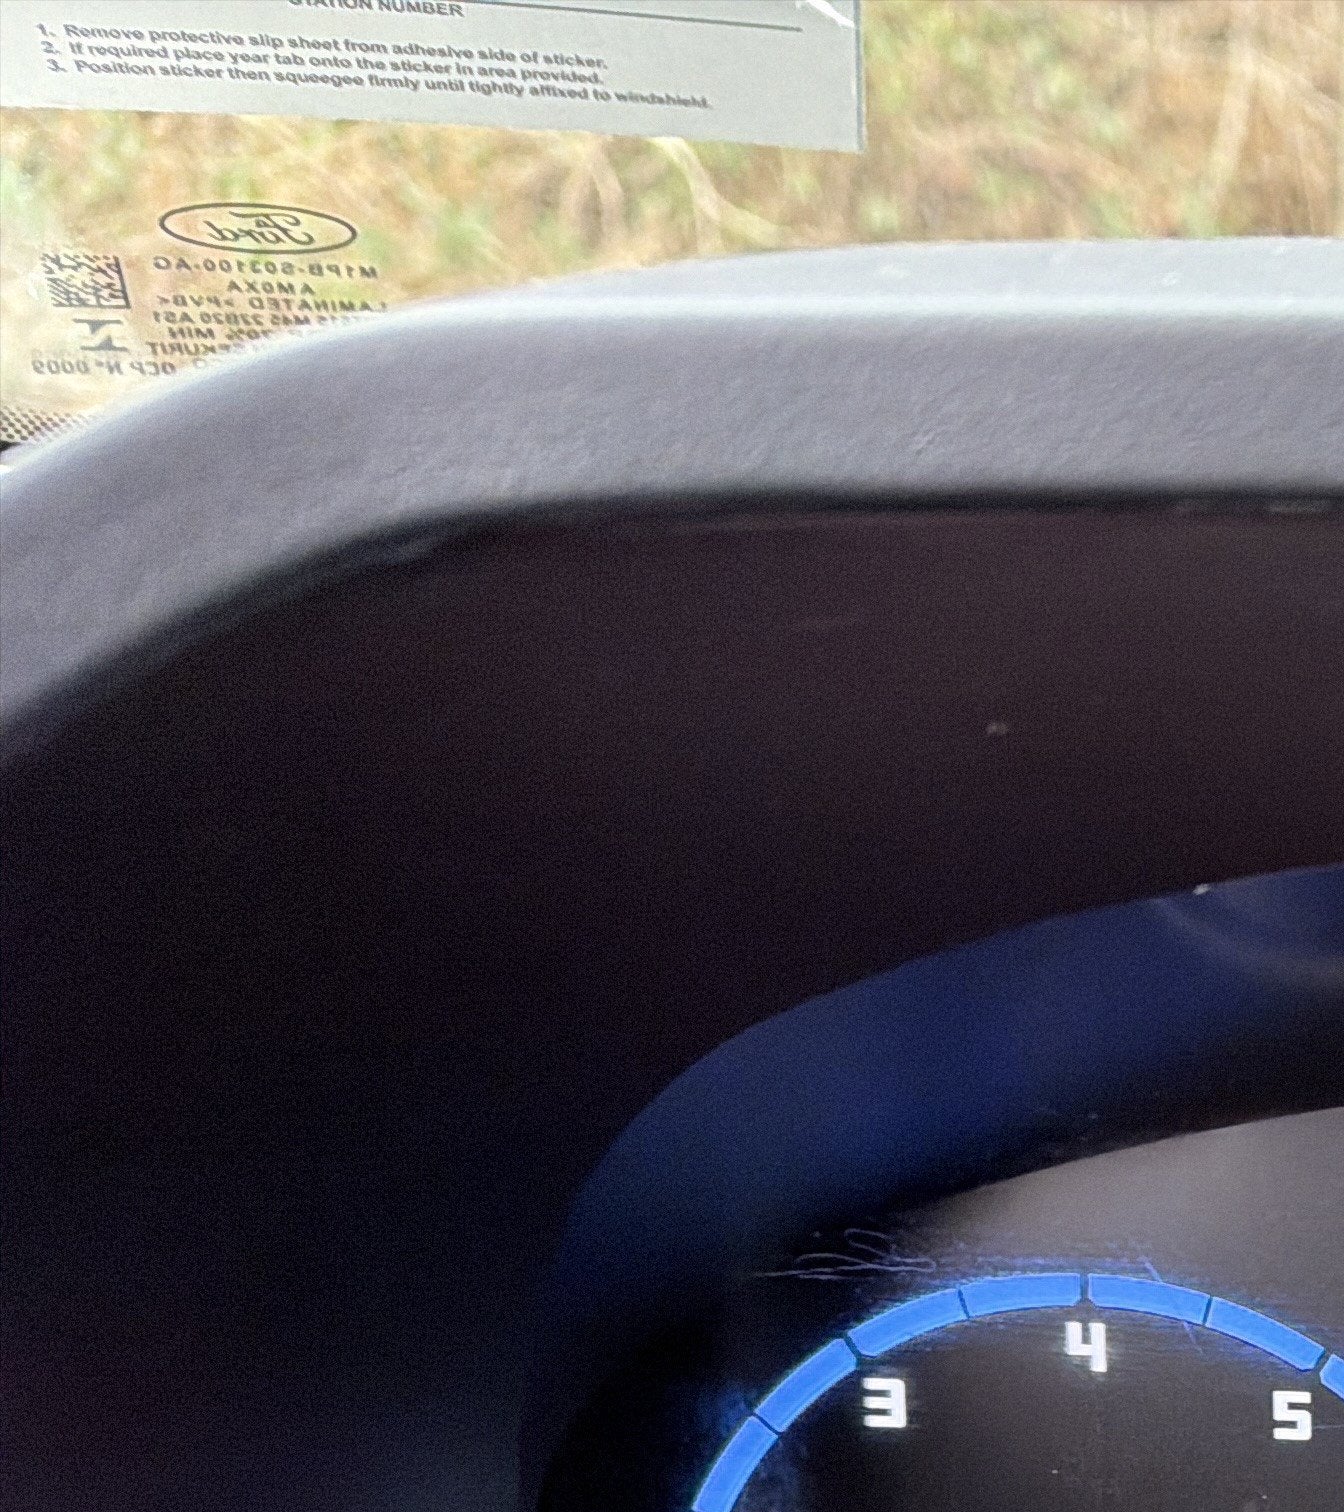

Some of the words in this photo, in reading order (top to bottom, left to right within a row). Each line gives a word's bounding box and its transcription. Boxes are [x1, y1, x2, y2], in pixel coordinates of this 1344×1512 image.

[378, 0, 465, 17] NUMBER
[37, 23, 56, 38] 1.
[63, 24, 145, 40] Remove
[149, 28, 245, 46] protective
[249, 34, 284, 50] slip
[287, 36, 341, 51] sheet
[343, 38, 388, 54] from
[391, 42, 474, 60] adhesive
[477, 48, 516, 62] side
[520, 50, 538, 64] of
[543, 53, 608, 70] sticker.
[40, 40, 61, 55] 2.
[69, 41, 83, 55] If
[87, 44, 169, 60] required
[173, 48, 225, 63] place
[228, 51, 269, 66] year
[274, 52, 305, 67] tab
[309, 55, 352, 69] onto
[355, 57, 386, 71] the
[390, 60, 452, 75] sticker
[456, 62, 473, 76] in
[477, 65, 517, 79] area
[521, 68, 604, 85] provided.
[74, 59, 156, 76] Position
[159, 63, 223, 79] sticker
[227, 67, 270, 82] then
[273, 70, 364, 88] squeegee
[367, 74, 419, 91] firmly
[425, 78, 465, 92] until
[468, 80, 524, 97] tightly
[529, 84, 589, 100] affixed
[593, 89, 611, 102] to
[1064, 1321, 1108, 1372] 4
[863, 1377, 907, 1428] 3
[1272, 1390, 1312, 1440] 5
